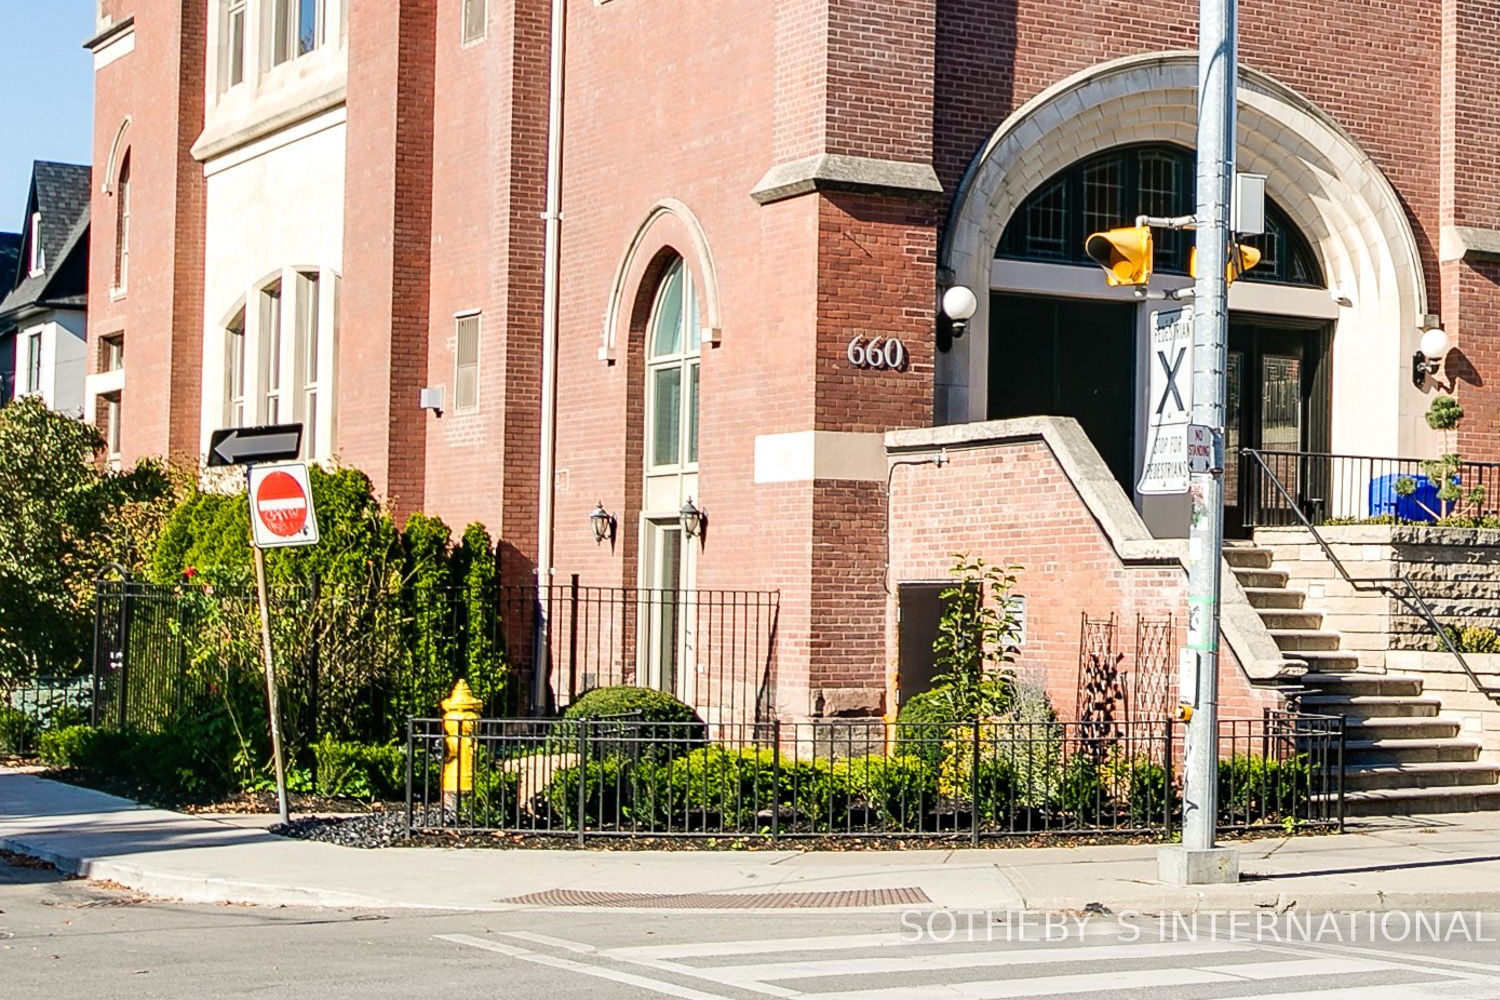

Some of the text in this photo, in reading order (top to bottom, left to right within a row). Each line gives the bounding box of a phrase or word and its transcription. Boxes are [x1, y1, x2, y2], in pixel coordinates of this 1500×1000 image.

[847, 333, 903, 368] 660
[1156, 346, 1187, 415] X
[1194, 429, 1204, 441] NO
